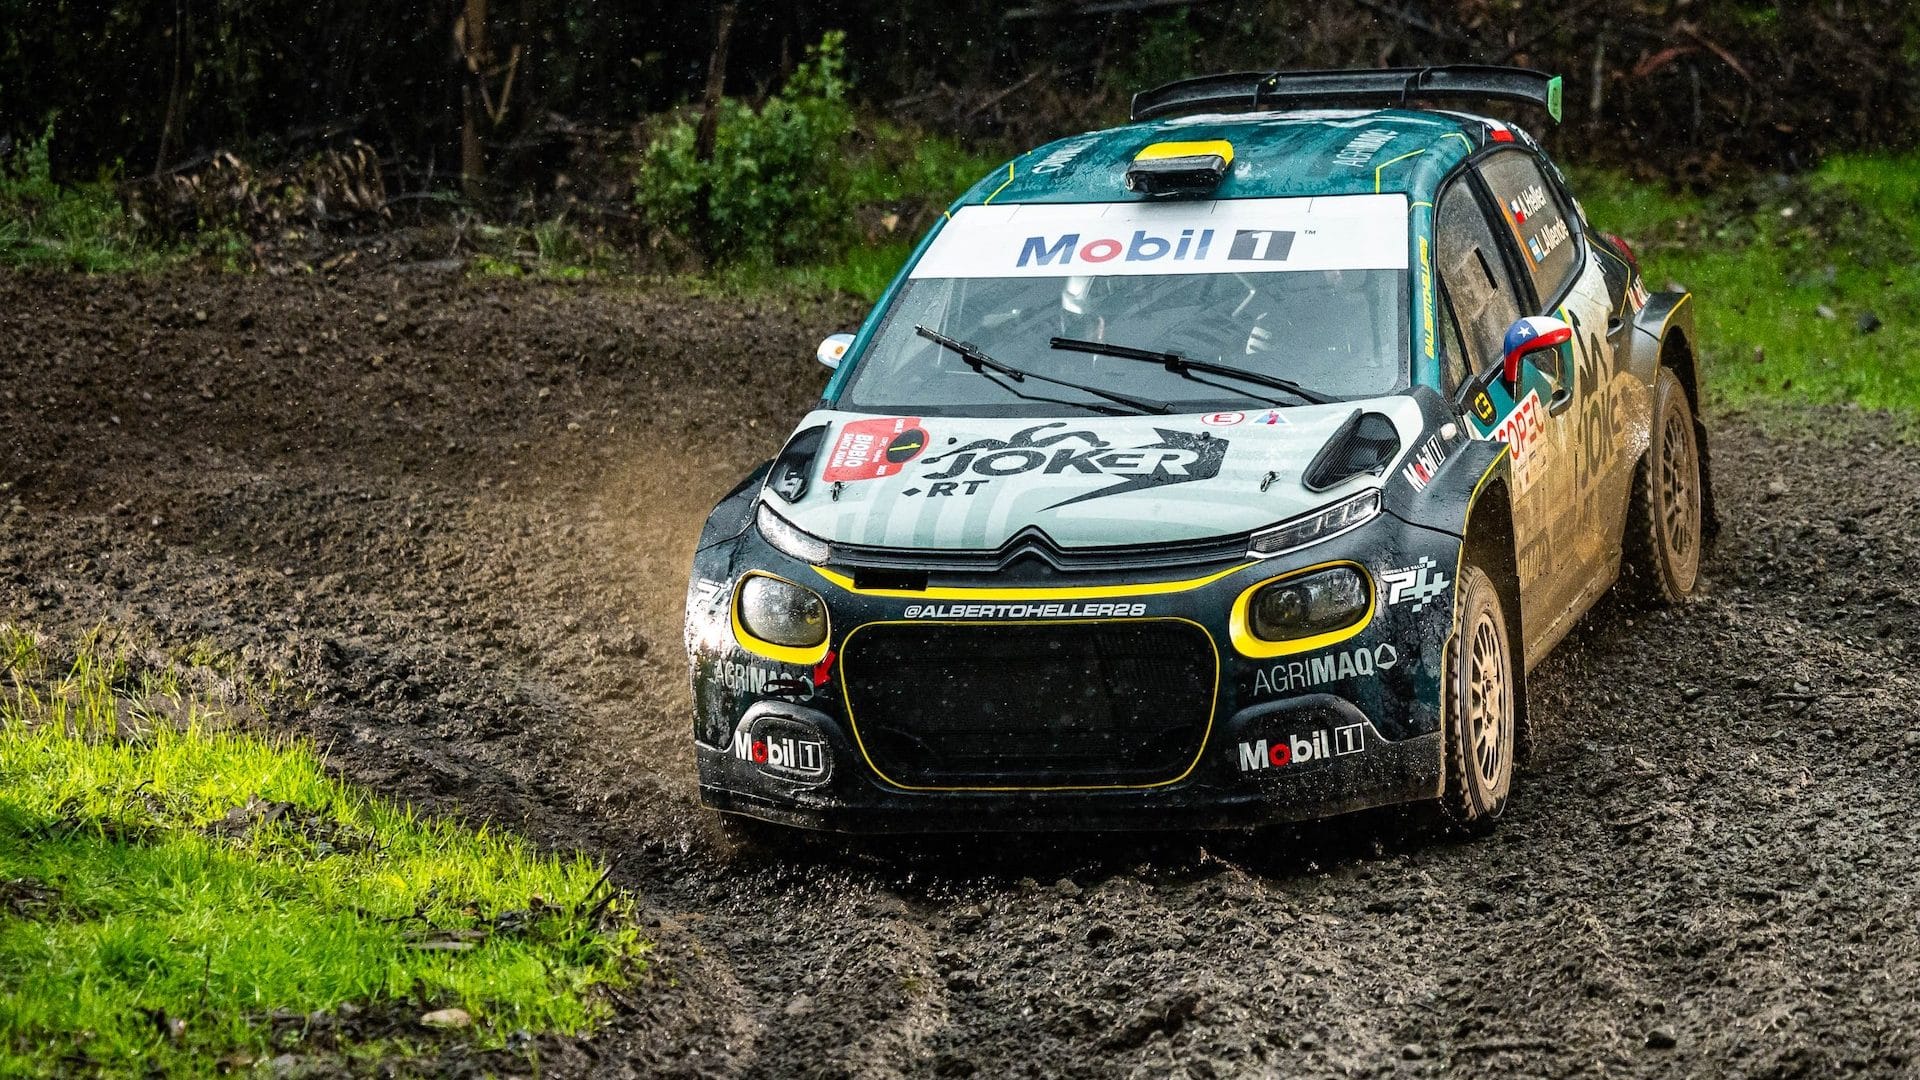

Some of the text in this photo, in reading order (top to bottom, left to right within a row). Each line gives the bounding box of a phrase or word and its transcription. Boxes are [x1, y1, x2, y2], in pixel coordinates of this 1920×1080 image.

[1016, 229, 1215, 267] Mobil
[921, 447, 1199, 480] JOKER
[1402, 444, 1439, 493] Mobil
[926, 480, 989, 497] RT
[904, 603, 1147, 619] @ALBERTOHELLER28
[1254, 648, 1375, 696] AGRIMAQ
[734, 730, 796, 767] Mobil
[1238, 729, 1331, 771] Mobil
